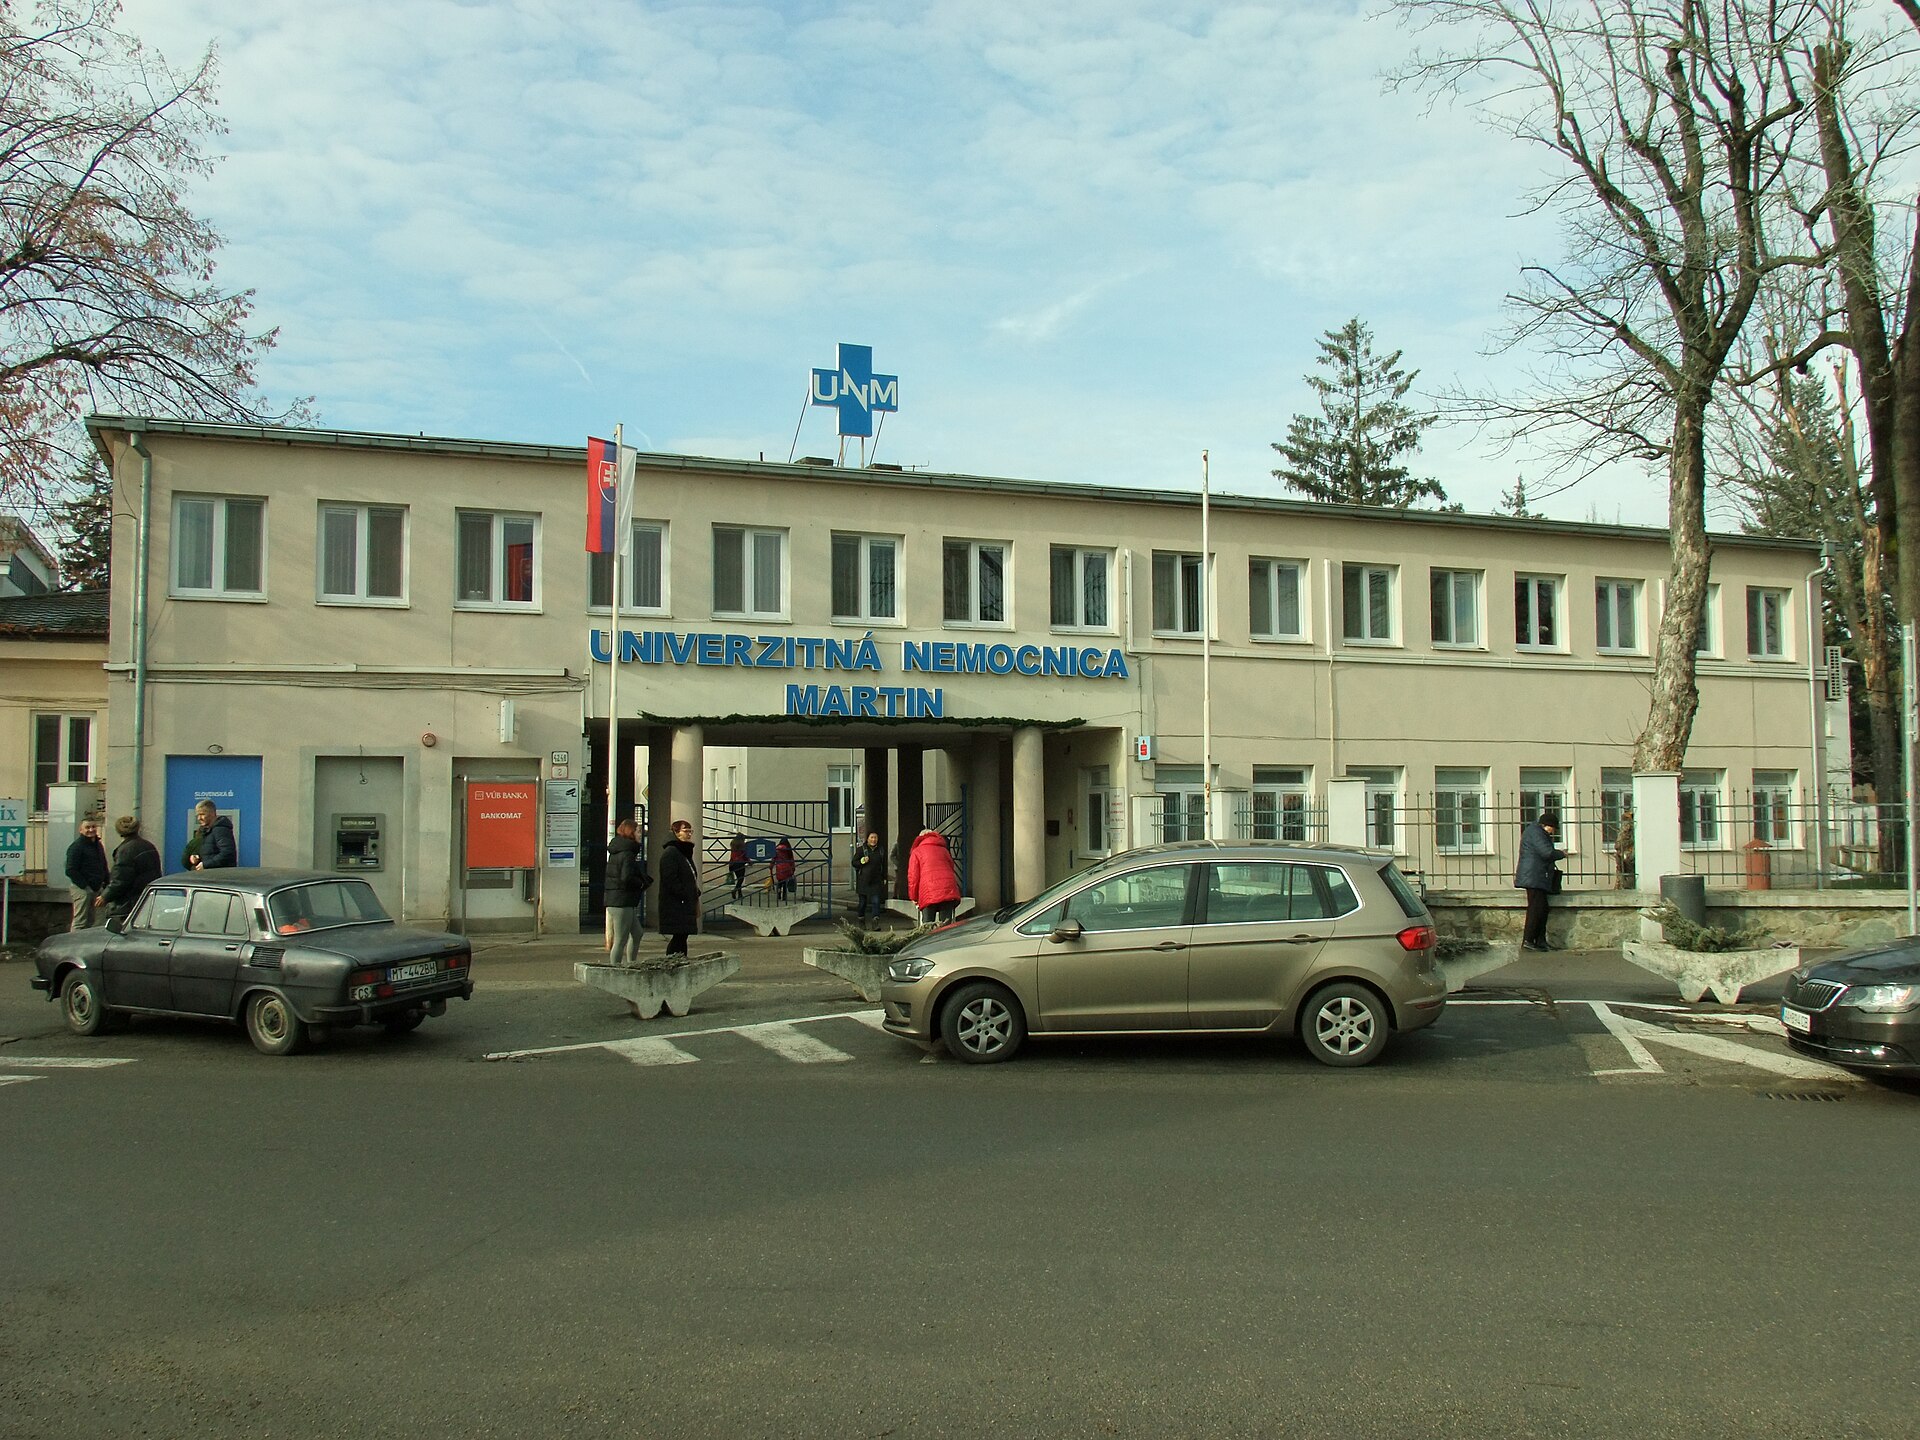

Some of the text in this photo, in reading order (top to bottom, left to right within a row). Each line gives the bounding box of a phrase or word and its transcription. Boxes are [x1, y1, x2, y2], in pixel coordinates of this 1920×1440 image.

[813, 367, 897, 413] UNM
[588, 629, 1130, 679] UNIVERZITNÁ NEMOCNICA
[784, 684, 944, 718] MARTIN
[485, 790, 501, 799] VÚB
